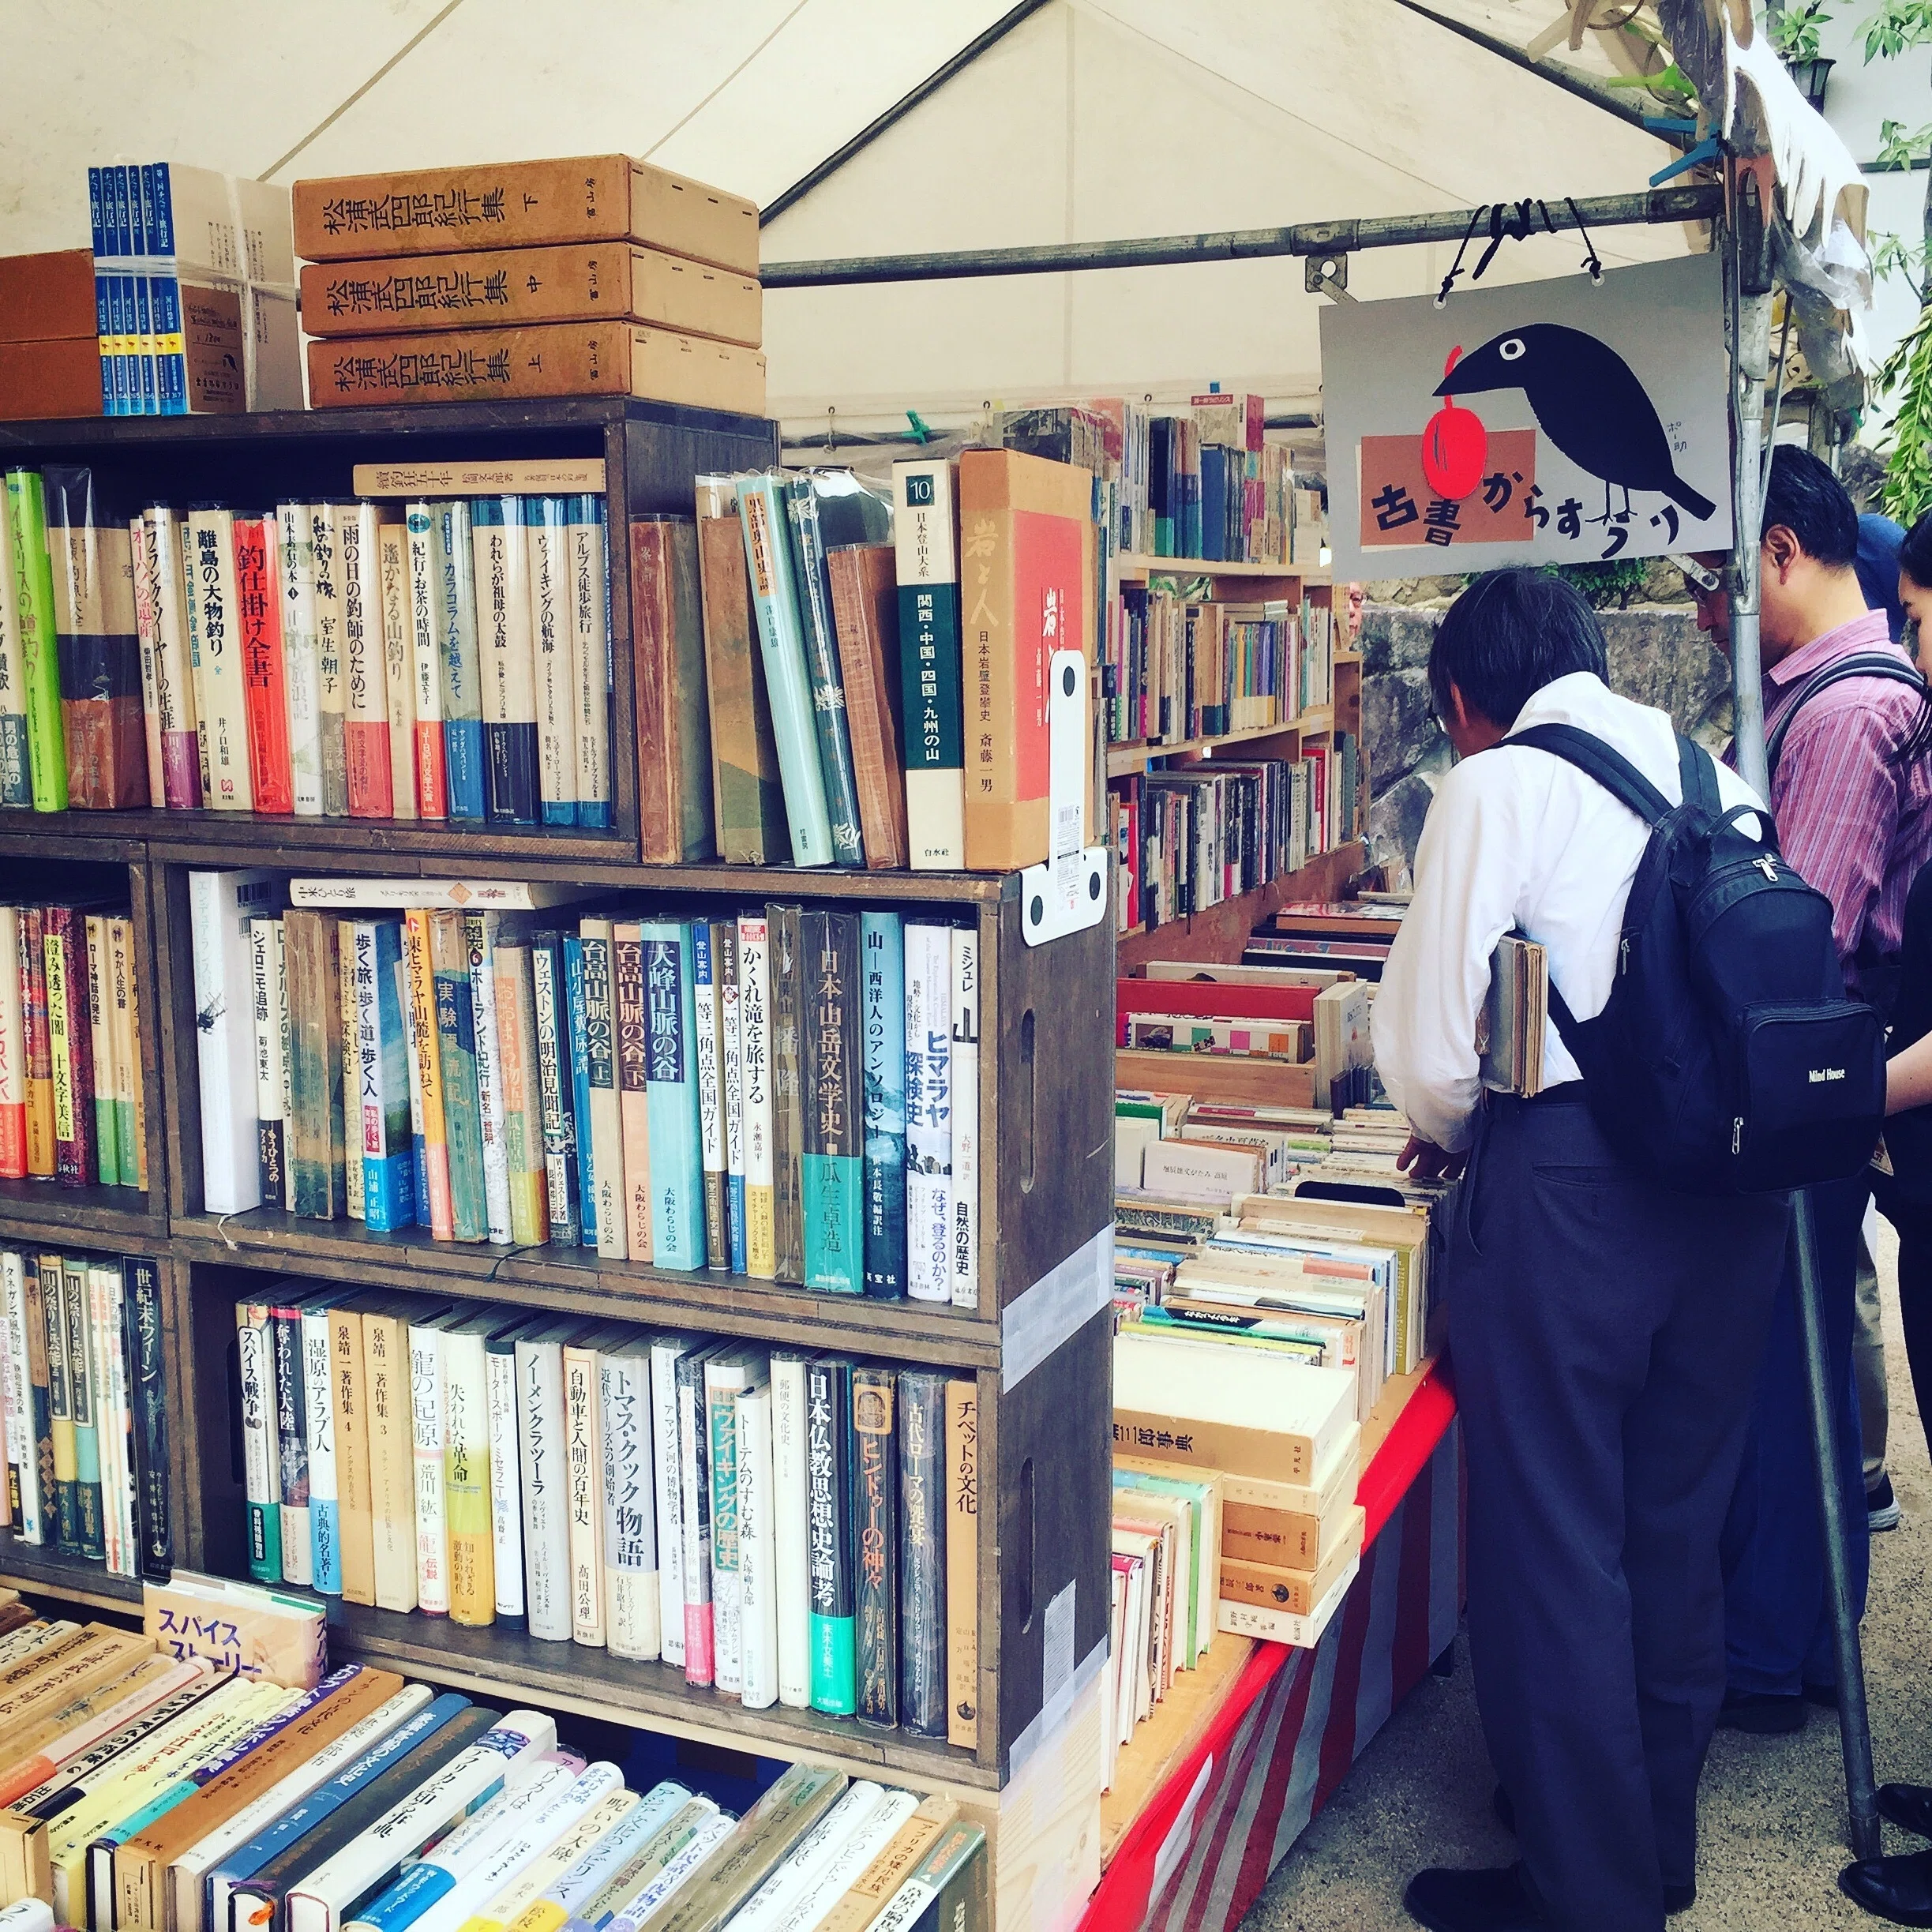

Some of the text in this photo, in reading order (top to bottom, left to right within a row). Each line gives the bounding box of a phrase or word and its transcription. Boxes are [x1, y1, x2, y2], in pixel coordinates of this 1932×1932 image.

[523, 193, 539, 213] 下
[525, 274, 543, 294] 中
[526, 353, 542, 373] 上
[911, 480, 931, 501] 10
[1371, 484, 1461, 546] 古書
[197, 530, 224, 657] 離島の大物釣り
[411, 542, 430, 647] 紀行・お茶の時間
[490, 535, 507, 647] われらが祖母の太鼓
[538, 535, 554, 653] ヴァイキングの航海
[576, 532, 592, 633] アルプス徒歩旅行
[917, 512, 930, 579] 日本登山大系
[966, 521, 999, 627] 岩と人
[146, 531, 175, 732] フランク・ソーヤーの生涯
[238, 545, 274, 688] 釣仕掛け全書
[321, 616, 338, 694] 室生朝子
[343, 523, 366, 709] 雨の日の釣師のために
[445, 562, 463, 700] カラコラムを越えて
[917, 594, 940, 761] 関西・中国・四国・九州の山
[978, 631, 992, 722] 日本岩壁登攀史
[925, 848, 950, 857] 白水社
[115, 950, 126, 1008] わが人生の書
[253, 931, 268, 1081] ジェロニモ追跡 菊池東太
[696, 940, 707, 979] 登山案内
[723, 939, 733, 976] 登山案内
[962, 946, 973, 992] ミシュレ
[47, 939, 69, 1138] 澄み透った闇 十文字美信
[355, 934, 378, 1097] 歩く旅・歩く道・歩く人
[409, 936, 433, 1097] 東ヒマラヤ山麓を訪ねて
[536, 954, 560, 1130] ウェストンの明治見聞記
[647, 943, 679, 1080] 大峰山脈の谷
[744, 947, 765, 1104] かくれ滝を旅する
[696, 992, 718, 1154] 一等三角点全国ガイド
[723, 1007, 741, 1165] 一等三角点全国ガイド
[818, 950, 845, 1252] 日本山岳文学史 瓜生卓造
[906, 1051, 924, 1127] 探検史
[926, 1030, 950, 1127] ヒマラヤ
[1826, 1067, 1845, 1081] House
[268, 1130, 279, 1182] もうひとつの
[602, 1180, 613, 1244] 大阪わらじの会
[635, 1184, 647, 1248] 大阪わらじの会
[664, 1187, 677, 1252] 大阪わらじの会
[956, 1201, 969, 1276] 自然の歴史
[135, 1269, 157, 1382] 世紀末ウィーン
[276, 1324, 295, 1431] 奪われた大陸
[337, 1326, 353, 1414] 泉靖一著作集
[309, 1339, 331, 1452] 湿原のアラブ人
[344, 1421, 351, 1432] 4
[372, 1327, 390, 1436] 泉靖一著作集 3
[451, 1383, 468, 1482] 失われた革命
[490, 1357, 505, 1497] モータースポーツ ミセラニー
[527, 1355, 544, 1495] ノーメンクラツーラ
[779, 1379, 790, 1446] 郵便の文化史
[570, 1369, 590, 1526] 自動車と人間の百年史
[601, 1368, 615, 1506] 近代ツーリズムの創始者
[615, 1371, 644, 1566] トマス・クック物語
[665, 1405, 678, 1525] アマゾン河の博物学者
[714, 1409, 739, 1566] ヴァイキングの歴史
[740, 1416, 756, 1540] トーテムのすむ森
[808, 1373, 835, 1606] 日本仏教思想史論考
[956, 1401, 977, 1514] チベットの文化
[861, 1440, 884, 1589] ヒンドゥーの神々
[452, 1540, 463, 1596] 激動の時代
[464, 1542, 475, 1596] 知られざる
[158, 1608, 242, 1648] スパイス
[123, 1711, 226, 1781] 小さな江戸を歩く
[369, 1748, 490, 1838] アフリカを知る事典
[511, 1758, 574, 1810] アメリカ人は
[574, 1769, 612, 1805] アメリカが
[546, 1788, 675, 1900] アジア文化のラビリンス
[548, 1796, 630, 1863] 呪いの大陸
[867, 1822, 934, 1894] アフリカの矮小民族
